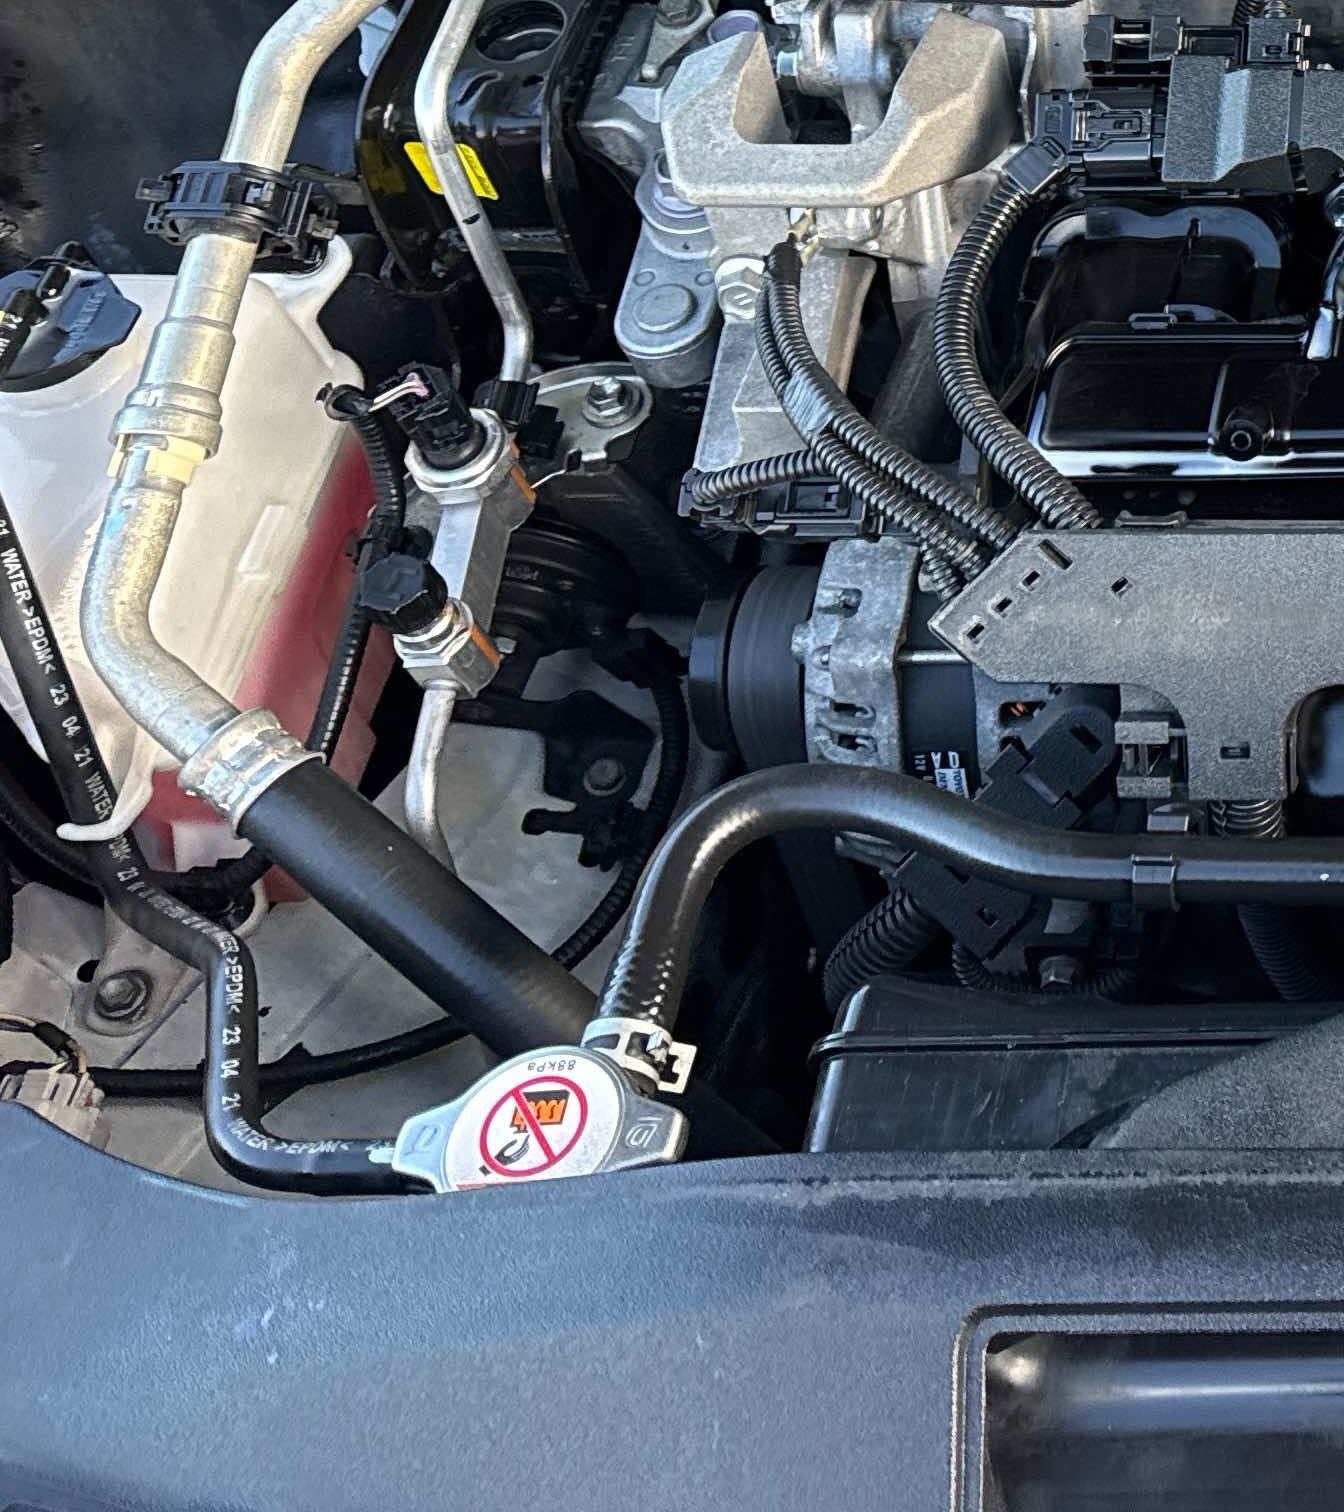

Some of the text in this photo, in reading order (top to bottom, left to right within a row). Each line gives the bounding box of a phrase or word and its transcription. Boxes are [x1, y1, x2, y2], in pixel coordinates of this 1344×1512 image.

[1, 548, 33, 604] WATER
[50, 683, 69, 707] 23
[62, 716, 82, 738] 04
[73, 746, 95, 769] 21
[84, 772, 113, 821] WATER
[222, 1026, 242, 1045] 23
[221, 1059, 240, 1079] 04
[527, 1058, 578, 1072] 88kPa
[221, 1093, 241, 1111] 21
